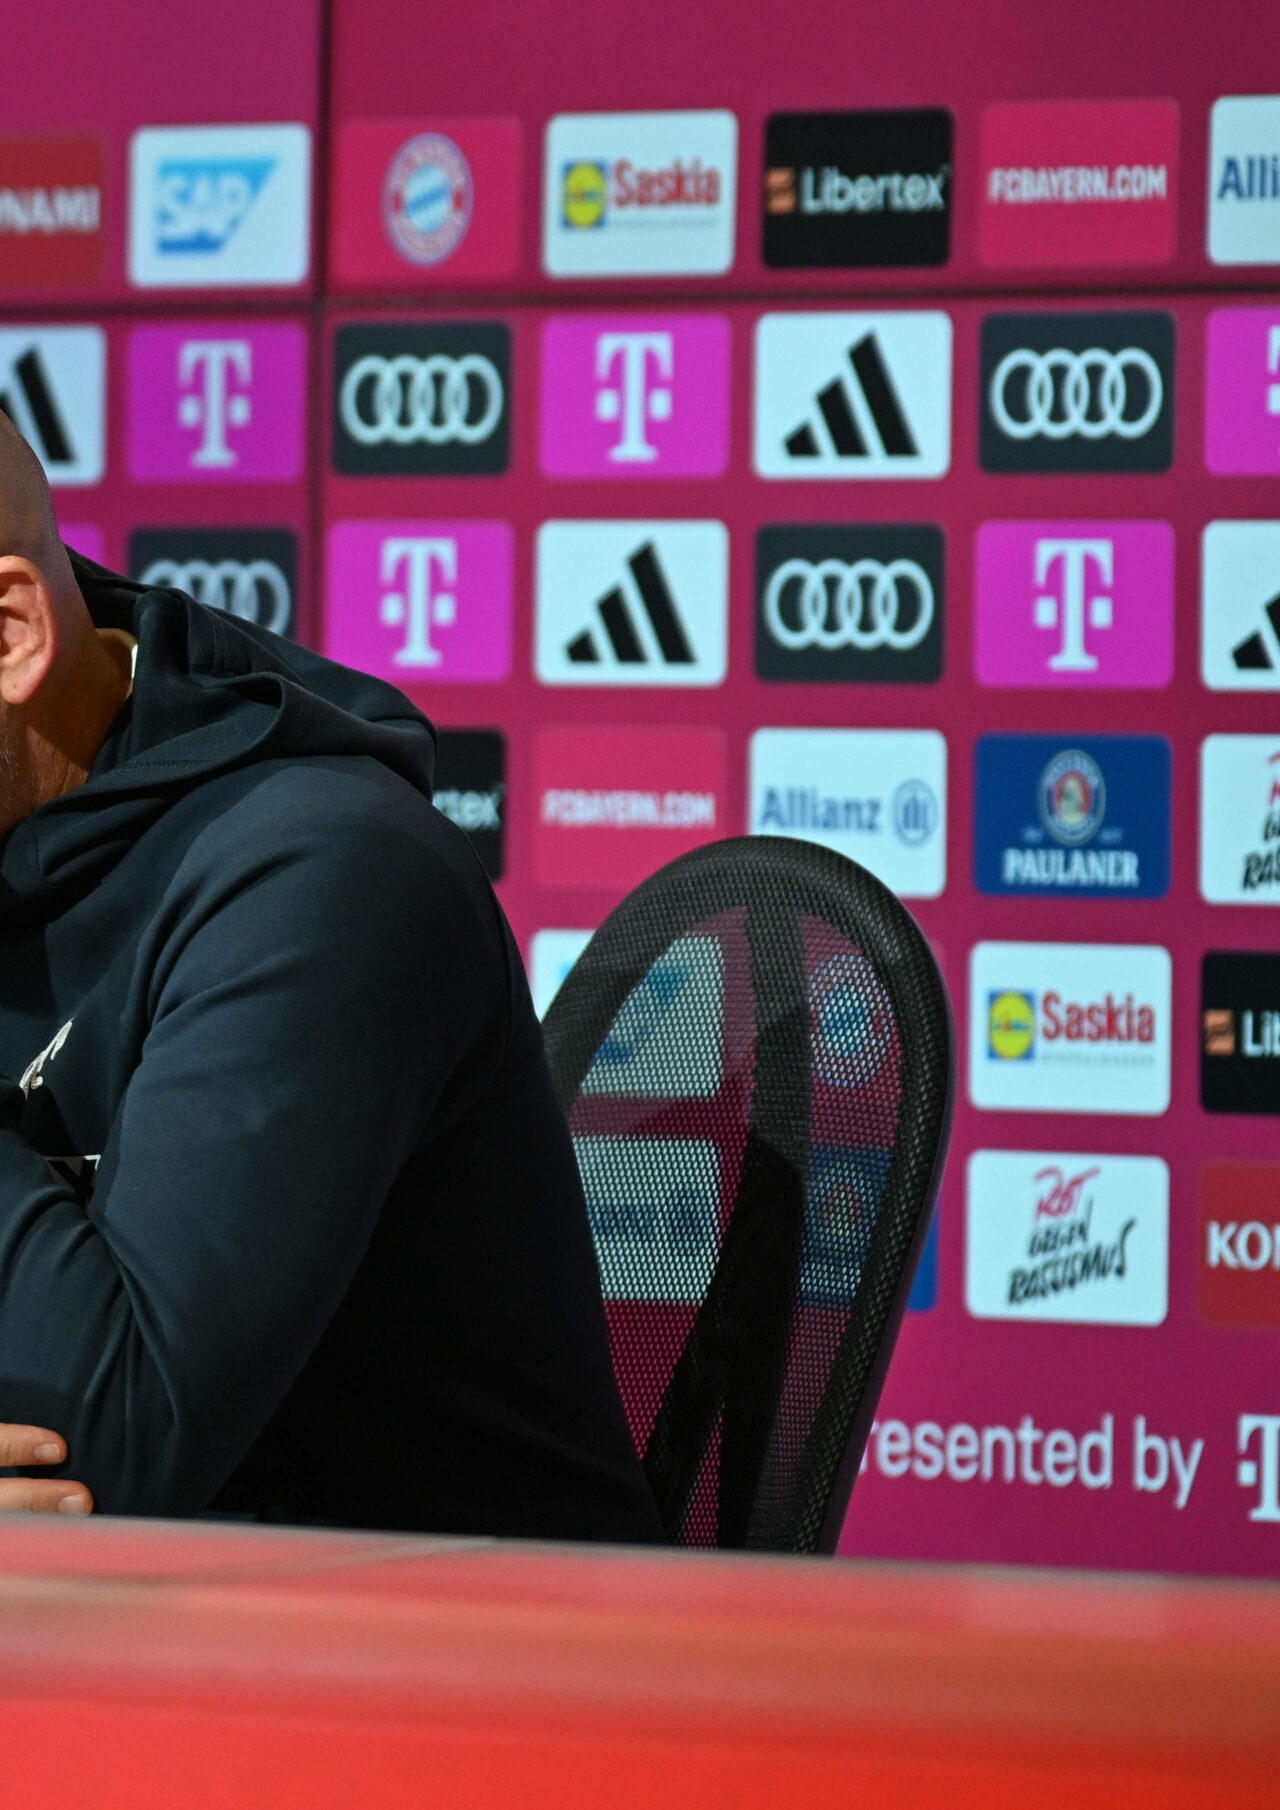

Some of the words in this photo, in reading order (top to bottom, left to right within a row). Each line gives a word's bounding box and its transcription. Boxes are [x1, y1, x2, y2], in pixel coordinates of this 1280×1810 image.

[615, 158, 720, 207] Saskia
[802, 165, 945, 214] Libertex
[990, 165, 1166, 204] FCBAYERN.COM
[542, 789, 715, 827] FCBAYERN.COM
[761, 784, 880, 831] Allianz
[1003, 848, 1139, 887] PAULANER
[1042, 990, 1154, 1044] Saskia
[1134, 1415, 1204, 1510] by
